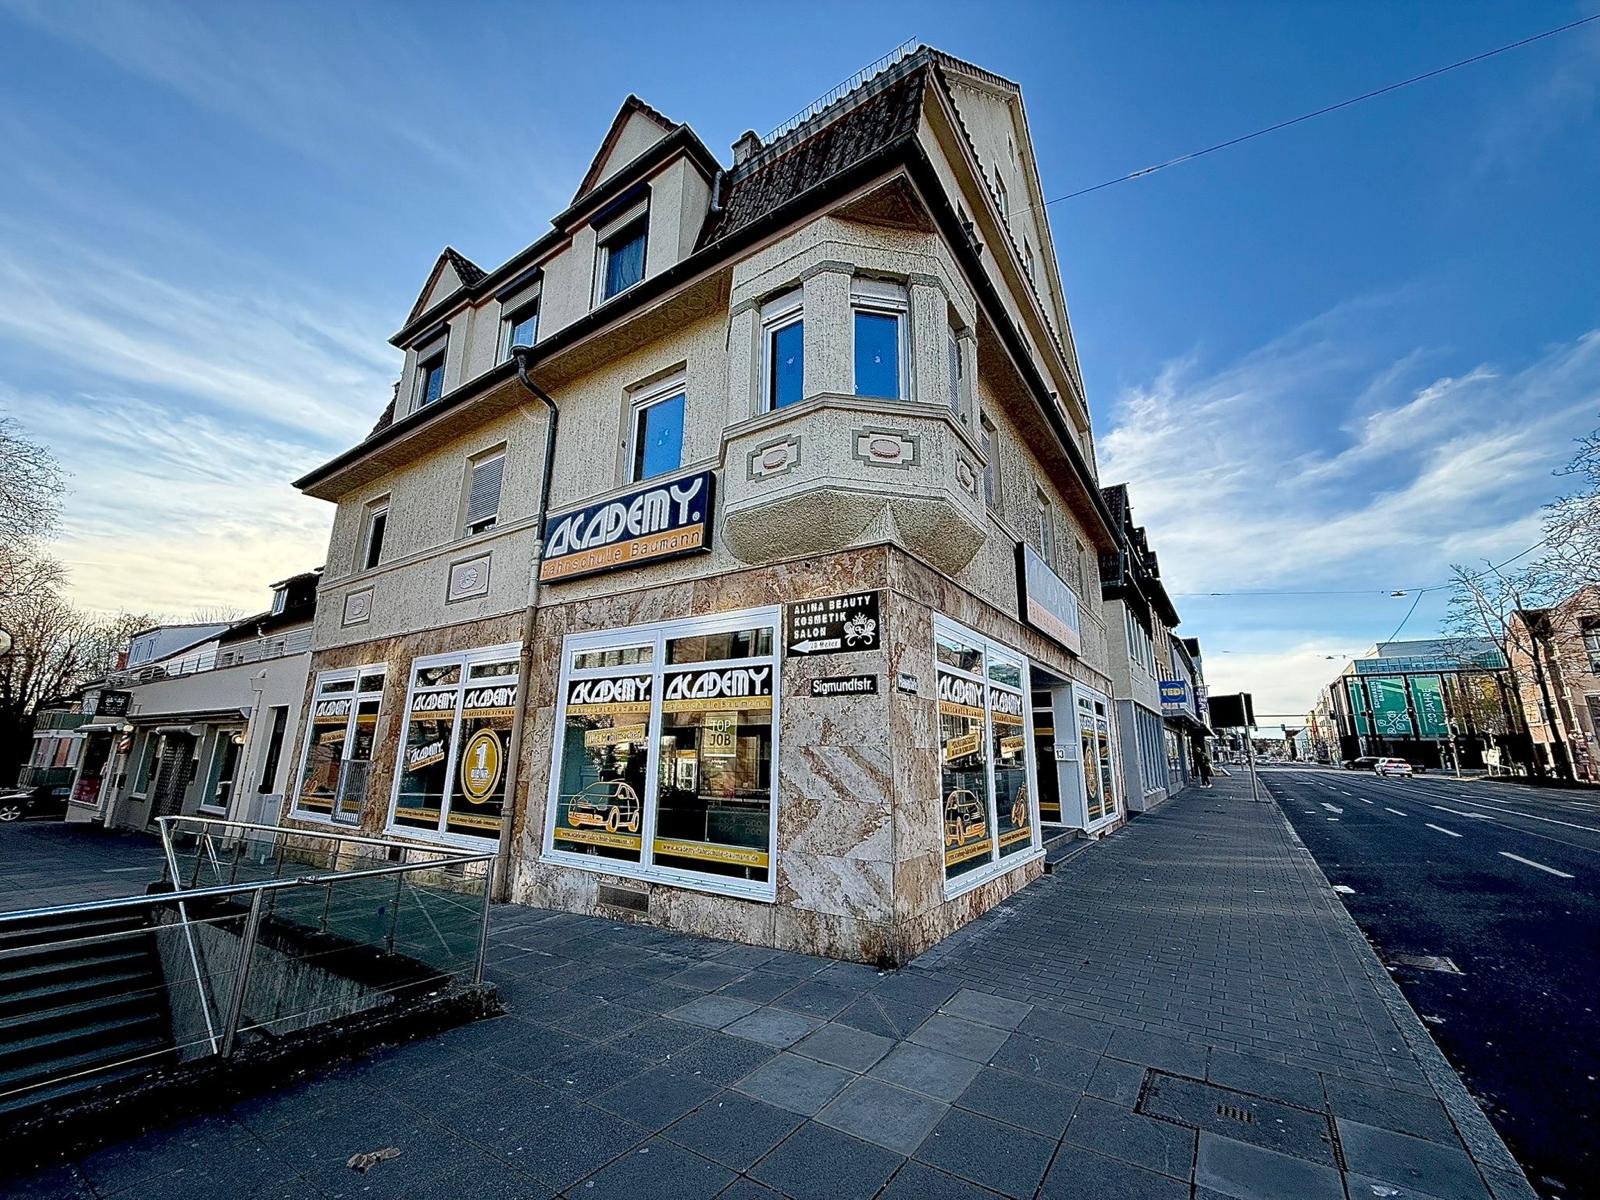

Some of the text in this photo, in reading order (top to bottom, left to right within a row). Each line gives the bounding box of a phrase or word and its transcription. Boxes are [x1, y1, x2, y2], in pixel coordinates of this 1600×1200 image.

[542, 530, 701, 577] Fahrschule Baumann
[794, 595, 871, 615] ALINA BEAUTY
[794, 612, 847, 627] KOSMETIK
[794, 627, 827, 639] SALON
[813, 678, 874, 694] Sigmundtstr.
[1423, 688, 1436, 712] JAHRE
[711, 719, 731, 732] TOP
[710, 734, 731, 746] JOB
